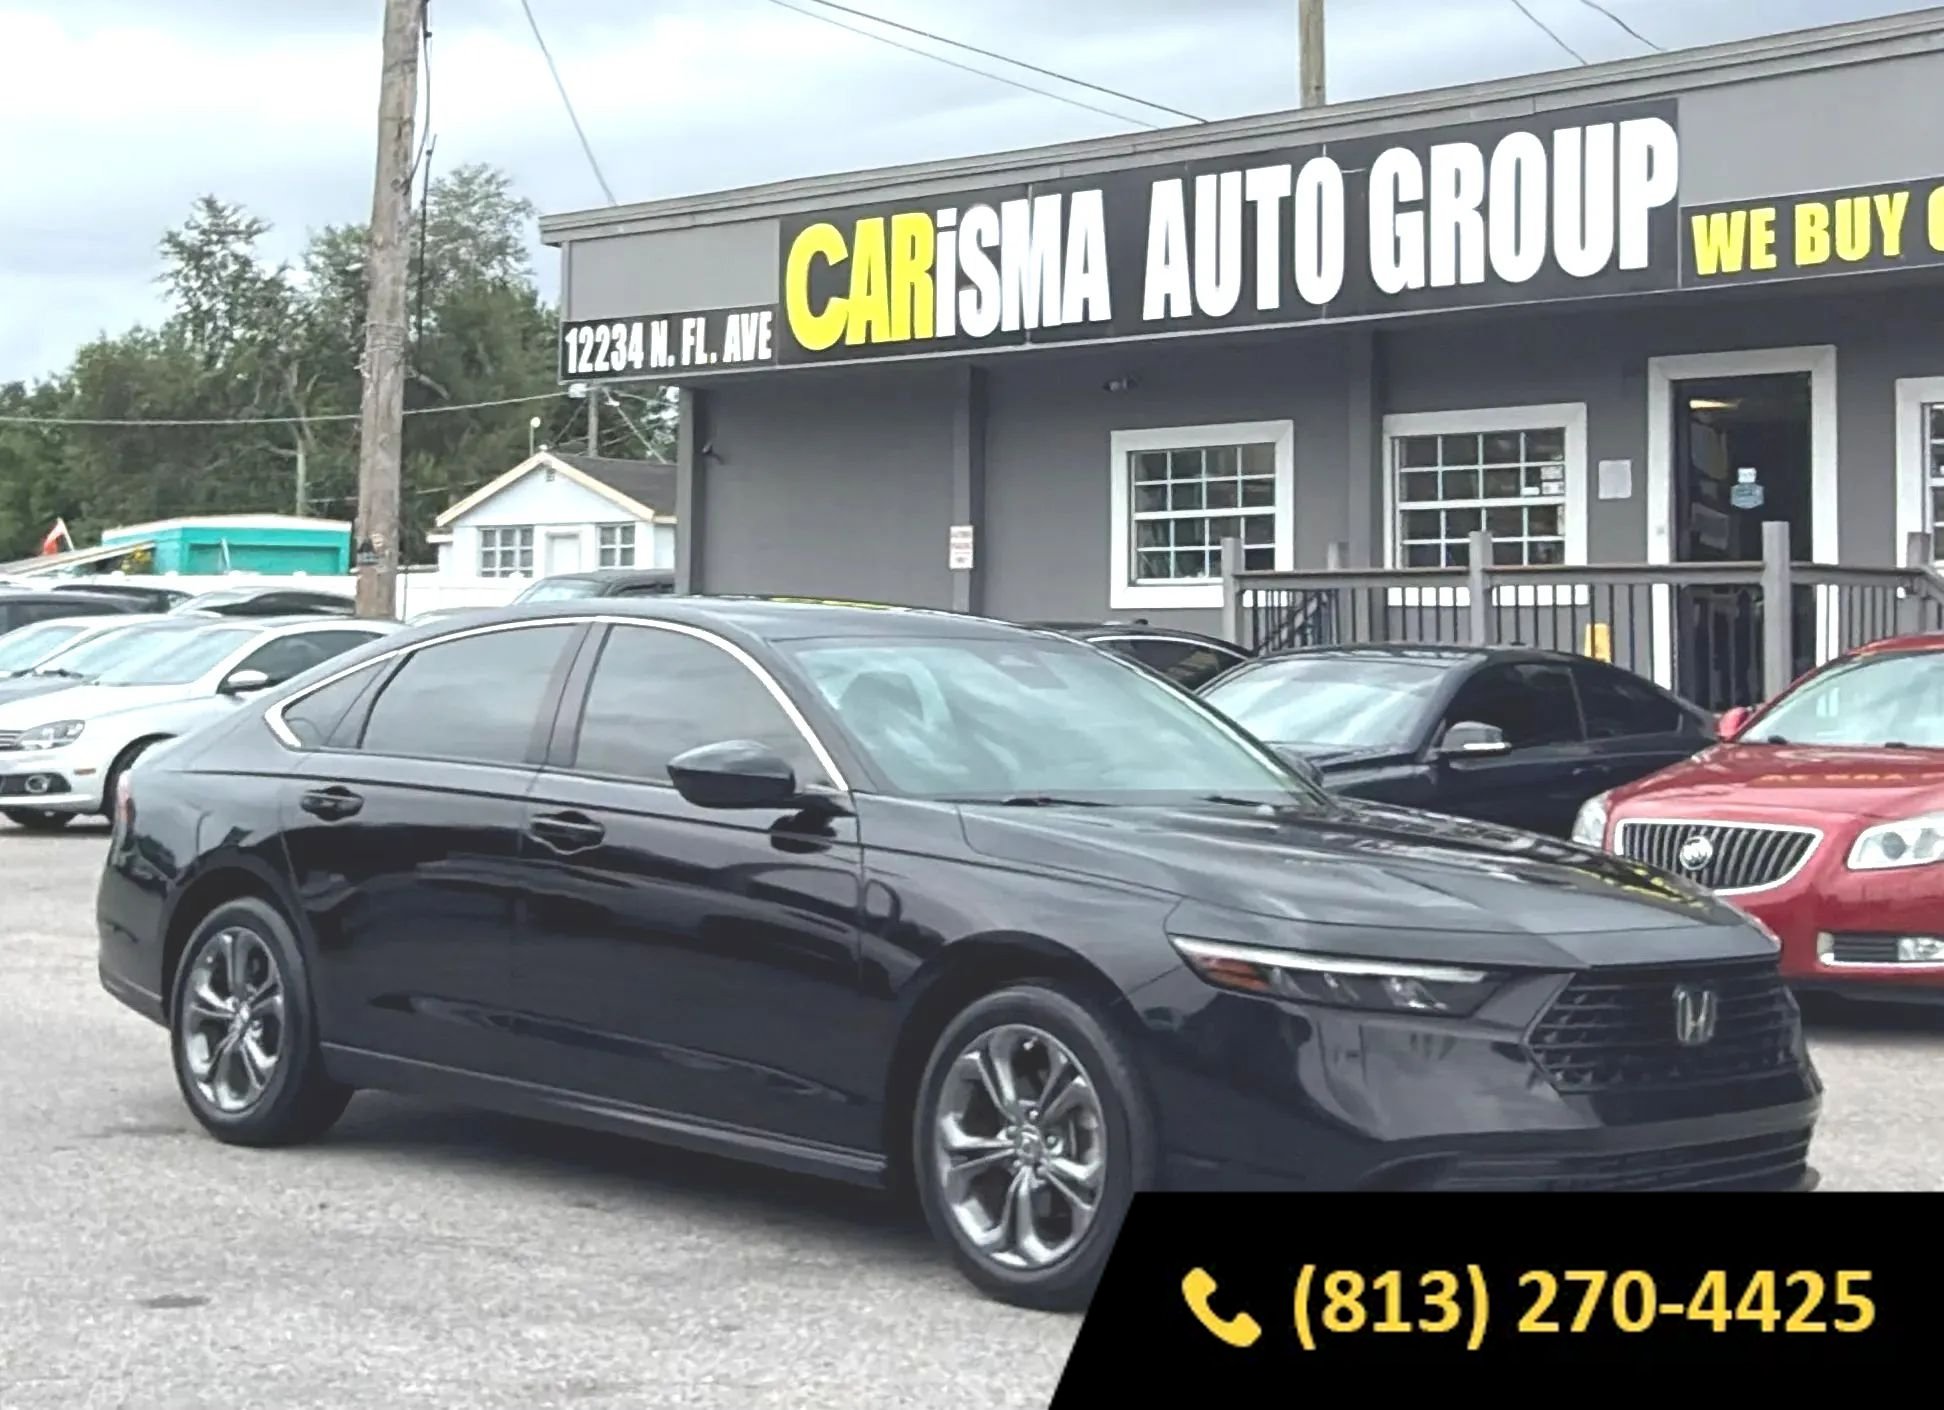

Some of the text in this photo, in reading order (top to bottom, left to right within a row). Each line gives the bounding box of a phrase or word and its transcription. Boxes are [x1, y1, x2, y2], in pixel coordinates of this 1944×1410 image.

[1143, 156, 1345, 321] AUTO
[1369, 117, 1679, 295] GROUP
[1691, 207, 1777, 275] WE
[1794, 191, 1909, 266] BUY
[564, 311, 772, 374] 12234 N. FL. AVE
